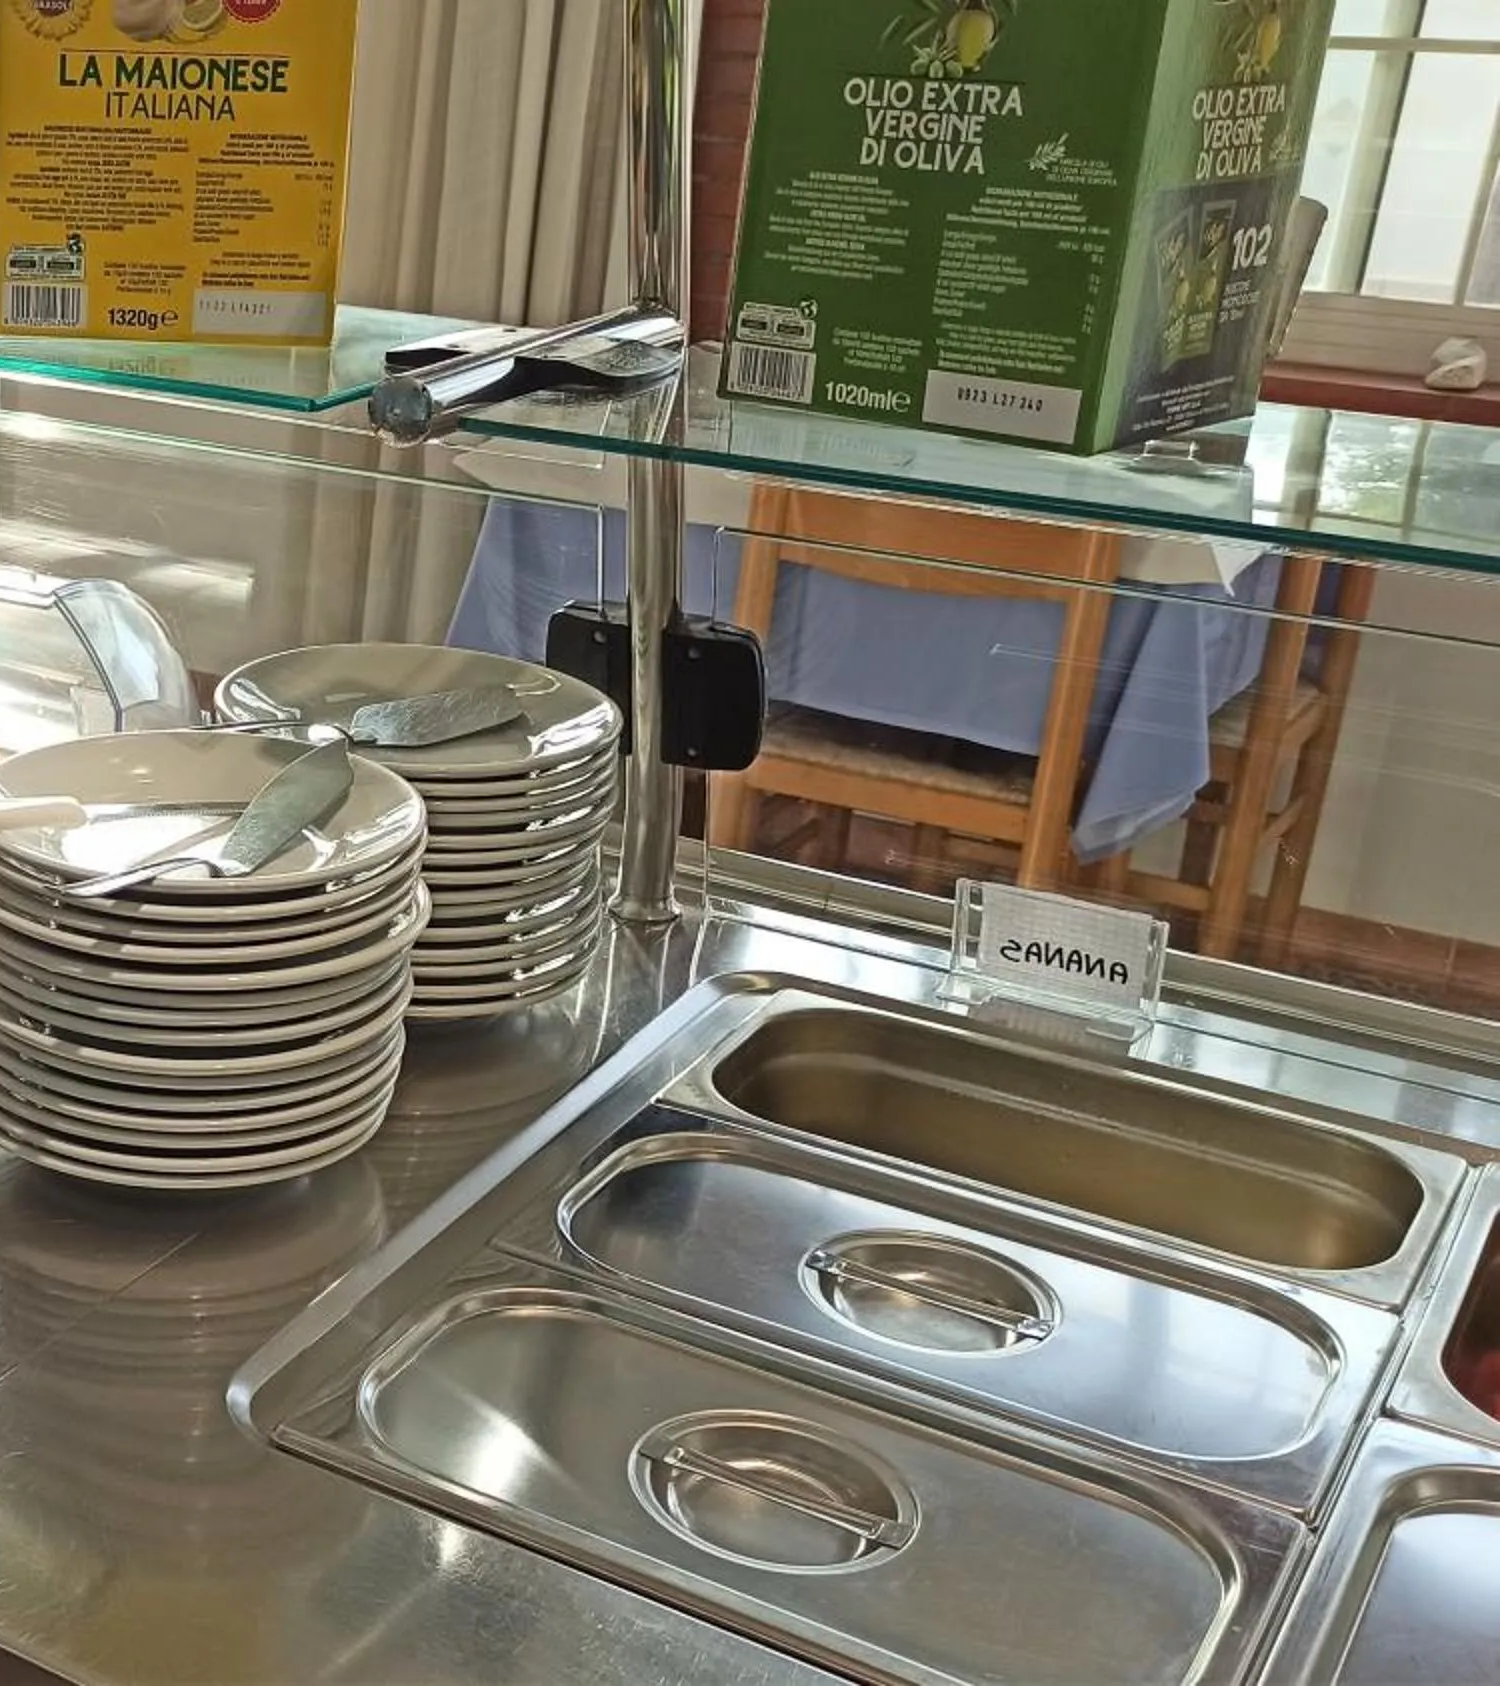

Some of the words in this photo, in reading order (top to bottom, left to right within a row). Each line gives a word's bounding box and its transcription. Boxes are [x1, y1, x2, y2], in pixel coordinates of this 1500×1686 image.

[59, 54, 102, 87] LA
[115, 55, 289, 93] MAIONESE
[105, 91, 235, 121] ITALIANA
[844, 78, 913, 108] OLIO
[922, 82, 1023, 116] EXTRA
[1191, 89, 1234, 119] OLIO
[1236, 84, 1286, 116] EXTRA
[866, 108, 986, 144] VERGINE
[1203, 115, 1267, 149] VERGINE
[860, 137, 887, 166] DI
[894, 141, 985, 174] OLIVA
[1196, 151, 1214, 180] DI
[1215, 146, 1262, 176] OLIVA
[1232, 224, 1272, 270] 102
